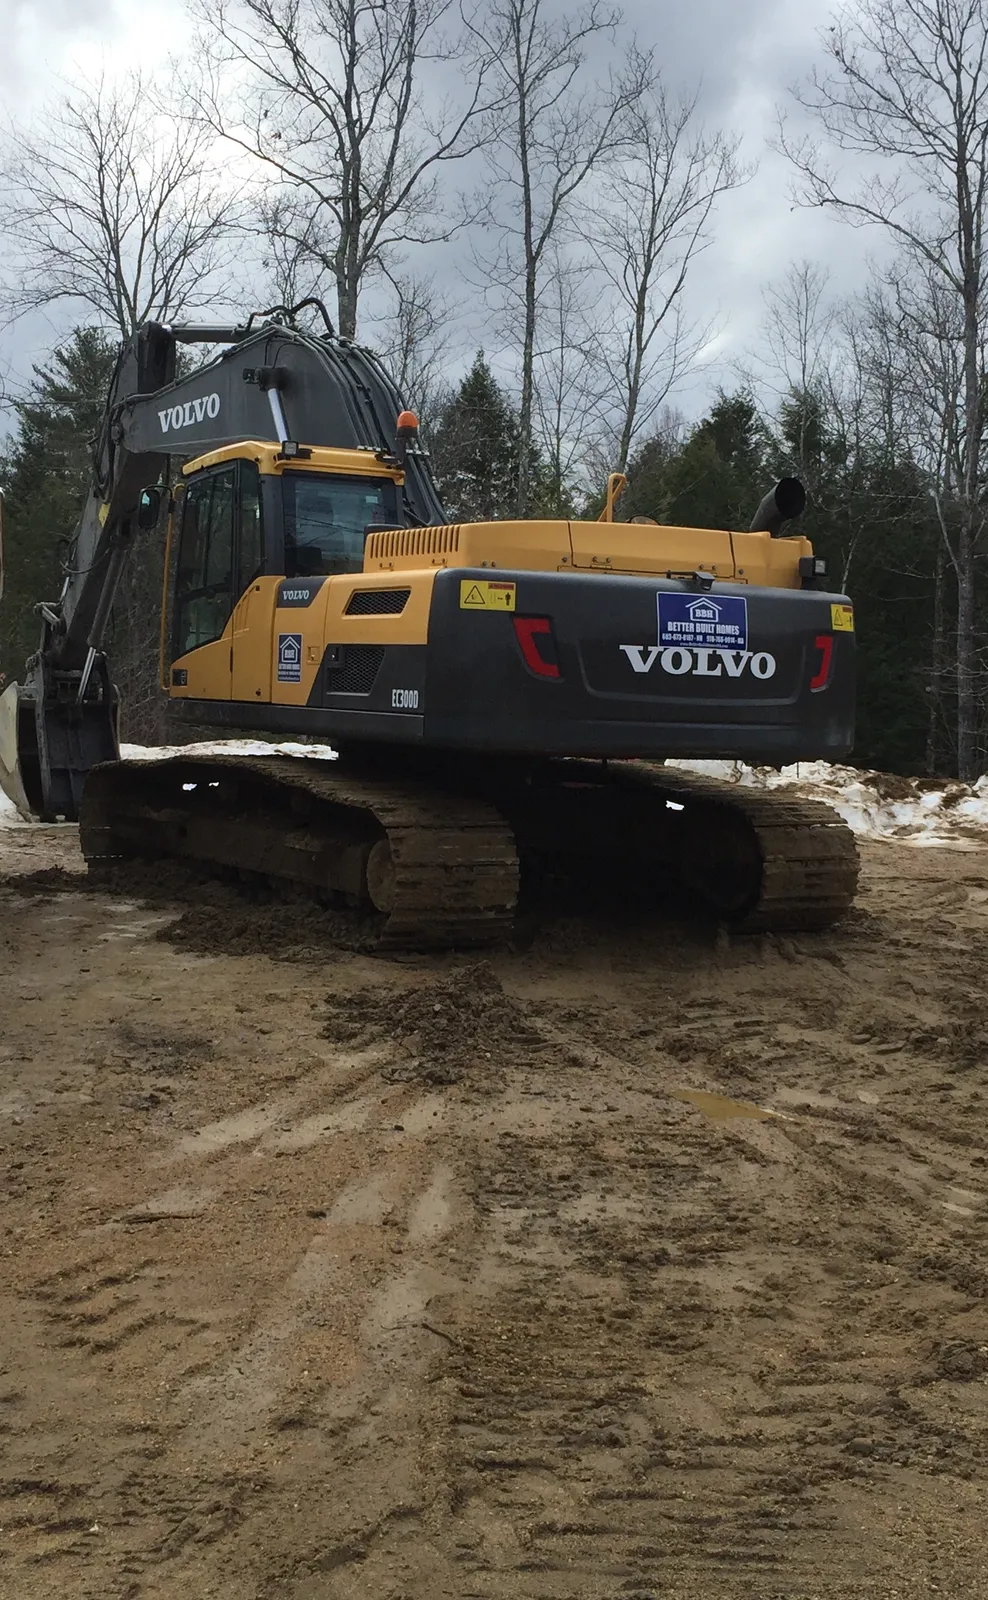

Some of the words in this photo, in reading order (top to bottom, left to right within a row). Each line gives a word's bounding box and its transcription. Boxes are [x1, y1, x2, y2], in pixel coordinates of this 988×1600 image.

[158, 393, 220, 433] VOLVO
[282, 589, 310, 600] VOLVO
[695, 608, 714, 618] BBH
[667, 621, 695, 633] BETTER
[695, 623, 715, 634] BUILT
[716, 624, 740, 636] HOMES
[619, 644, 777, 680] VOLVO
[391, 689, 419, 709] EC300D
